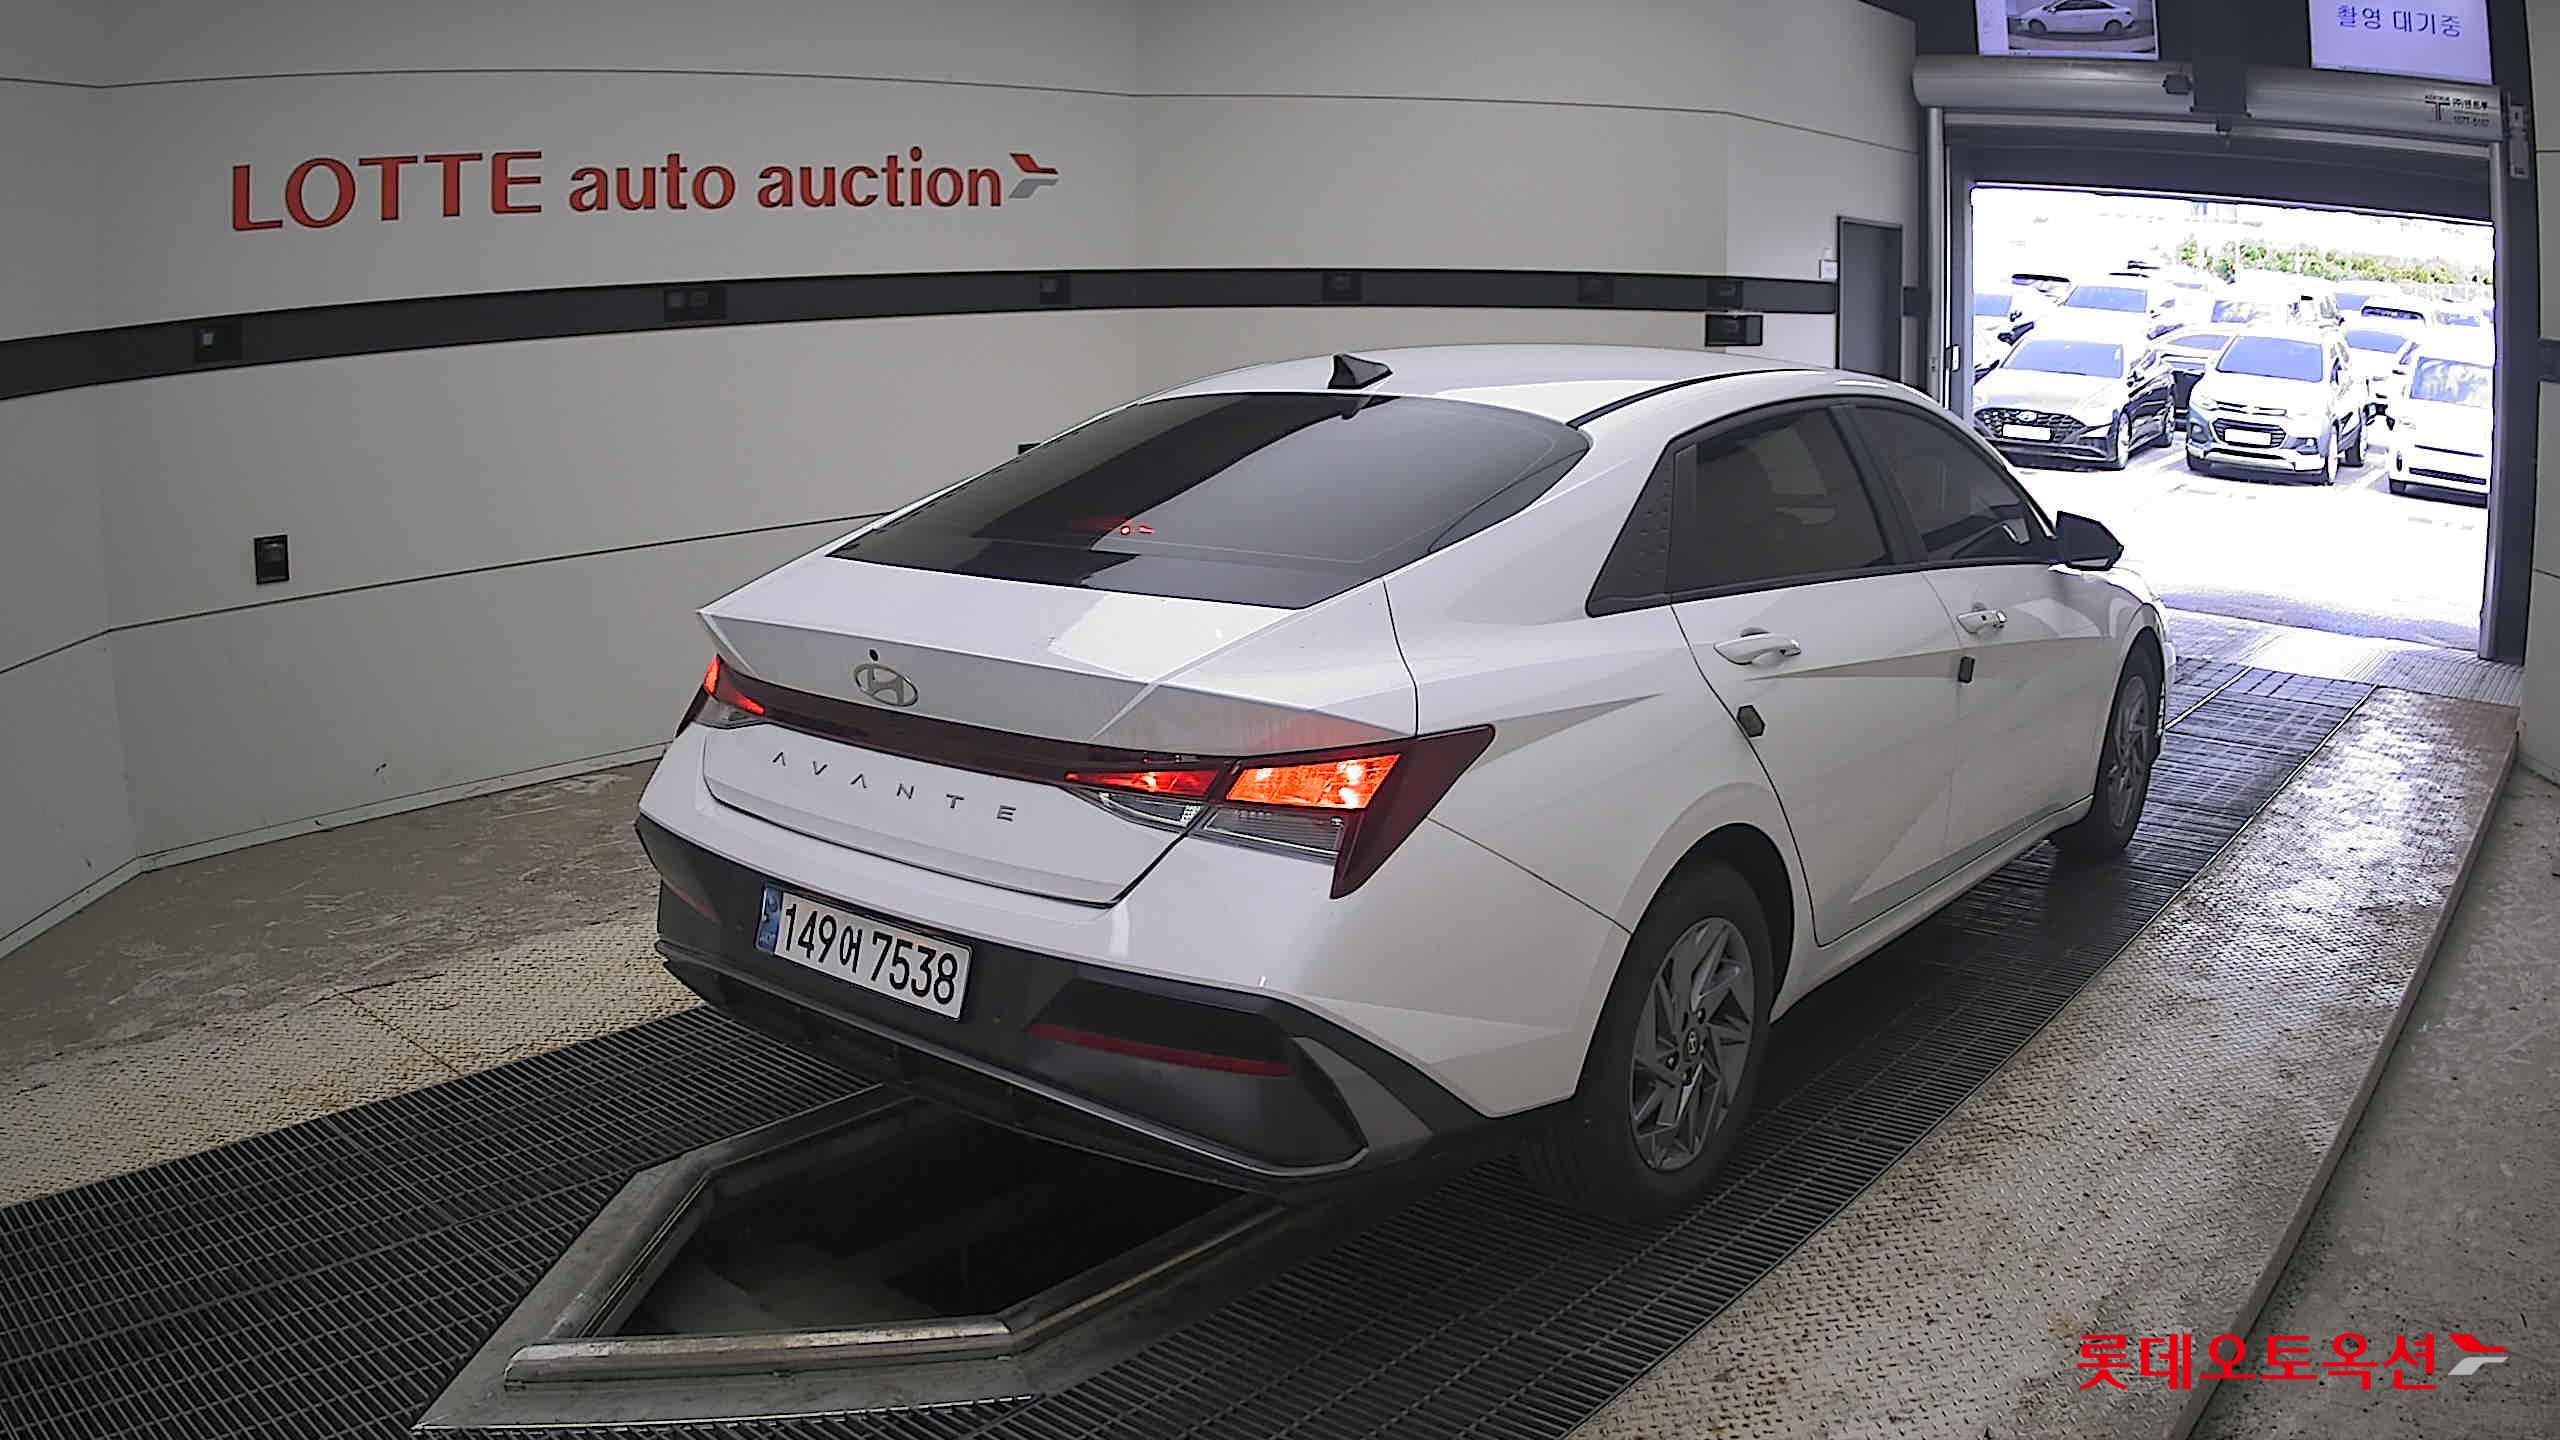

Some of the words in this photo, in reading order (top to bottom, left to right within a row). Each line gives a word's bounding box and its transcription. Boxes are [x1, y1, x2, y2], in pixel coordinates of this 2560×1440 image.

[2337, 4, 2382, 31] 촬영
[2392, 10, 2462, 38] 대기중
[232, 150, 542, 231] LOTTE
[568, 152, 736, 213] auto
[756, 145, 1002, 207] auction
[772, 751, 1016, 822] AVANTE
[784, 903, 863, 974] 149어
[870, 930, 958, 1005] 7538
